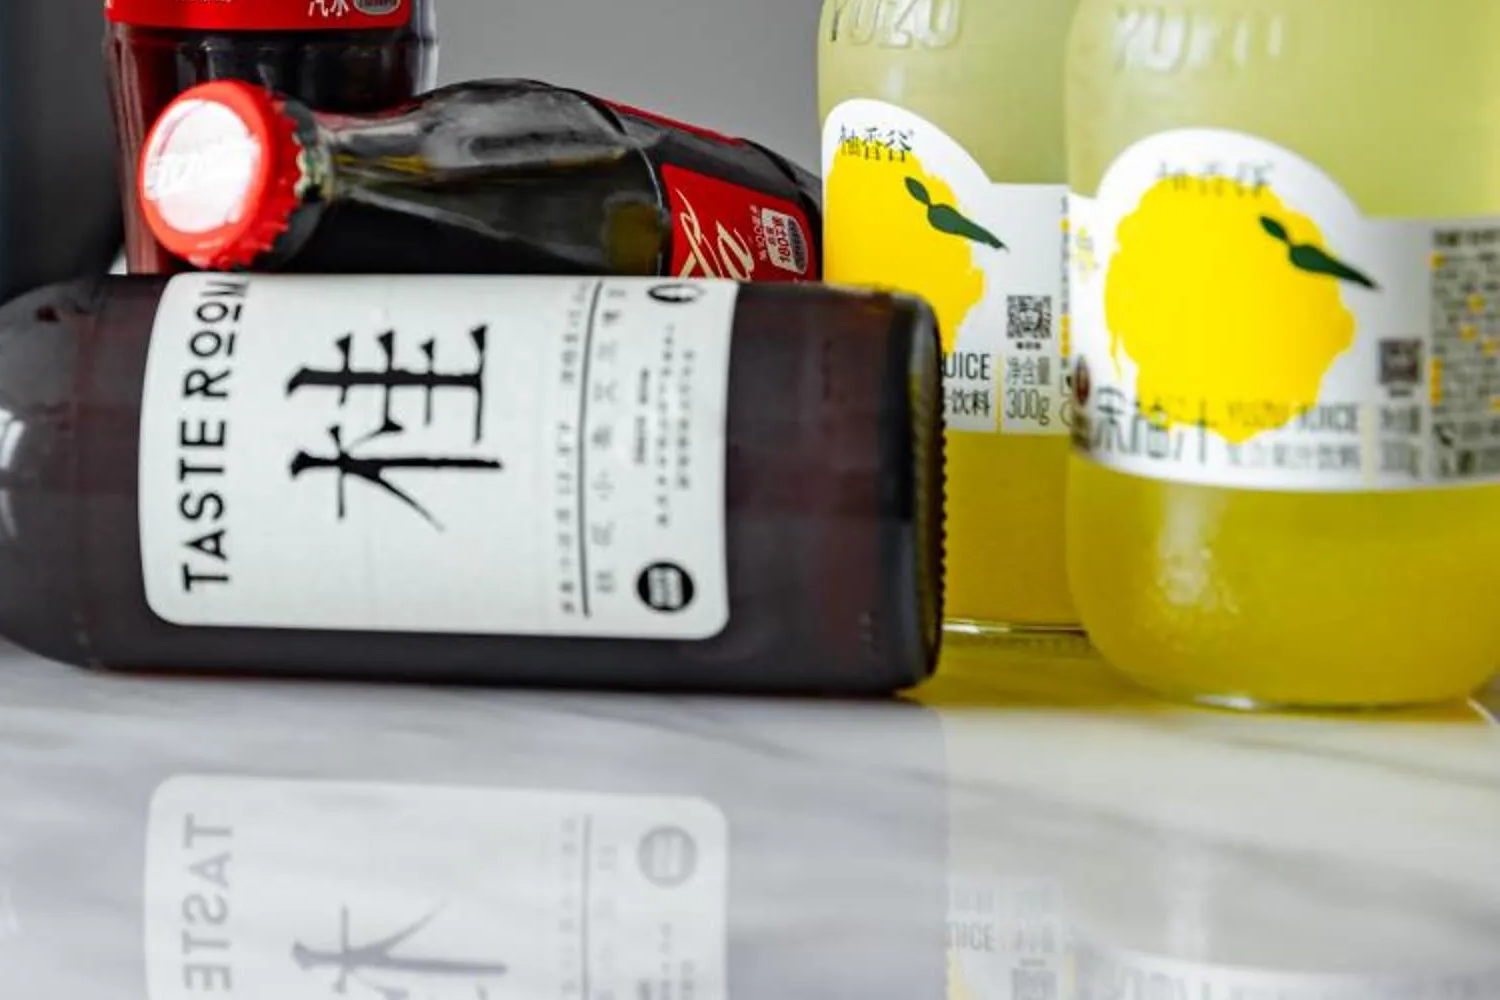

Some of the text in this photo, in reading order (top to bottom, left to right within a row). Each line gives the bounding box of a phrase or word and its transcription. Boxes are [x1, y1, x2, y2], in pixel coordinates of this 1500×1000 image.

[1007, 357, 1051, 386] 净含量
[944, 391, 991, 423] 饮料
[1006, 389, 1051, 427] 300g
[179, 279, 249, 593] TASTE ROOM
[286, 322, 504, 532] 桂
